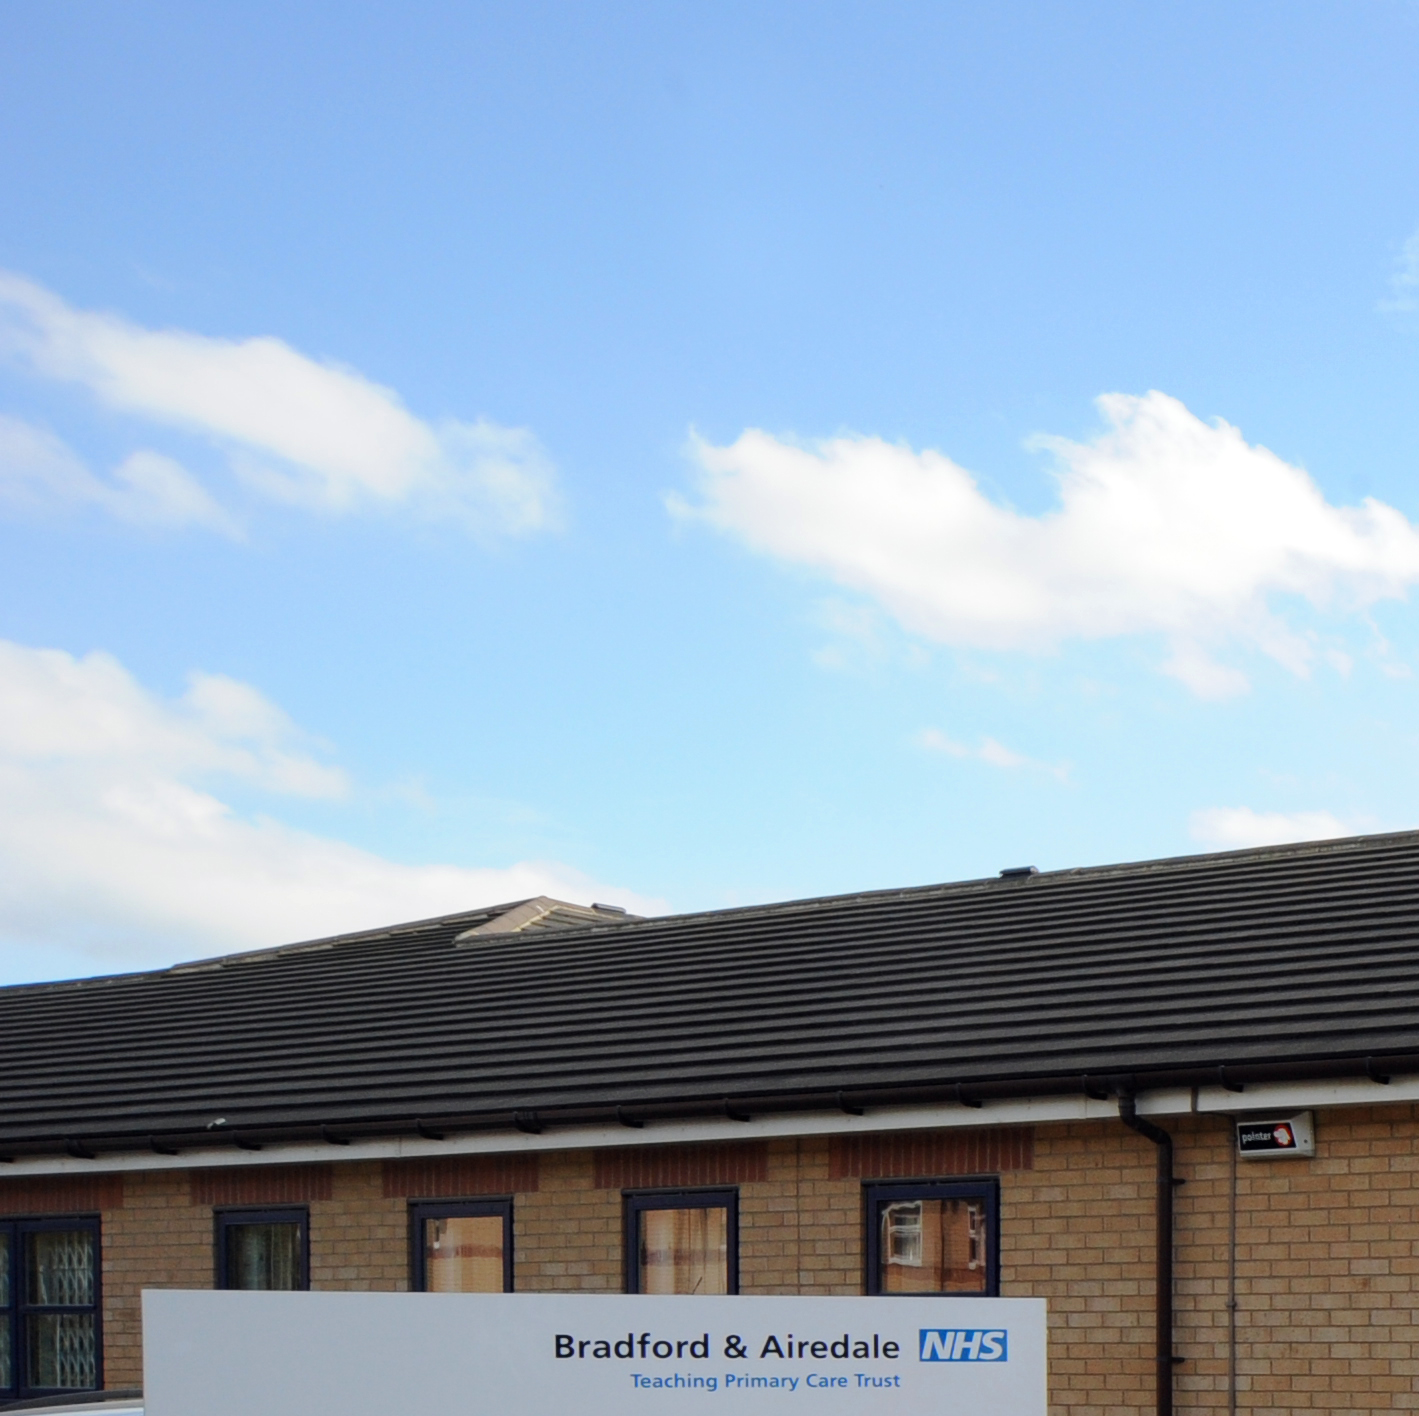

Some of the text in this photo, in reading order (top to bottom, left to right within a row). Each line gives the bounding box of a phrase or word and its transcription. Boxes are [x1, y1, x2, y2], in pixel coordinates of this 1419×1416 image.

[555, 1332, 901, 1360] Bradford & Airedale
[921, 1330, 1007, 1362] NHS
[630, 1372, 901, 1393] Teaching Primary Care Trust
